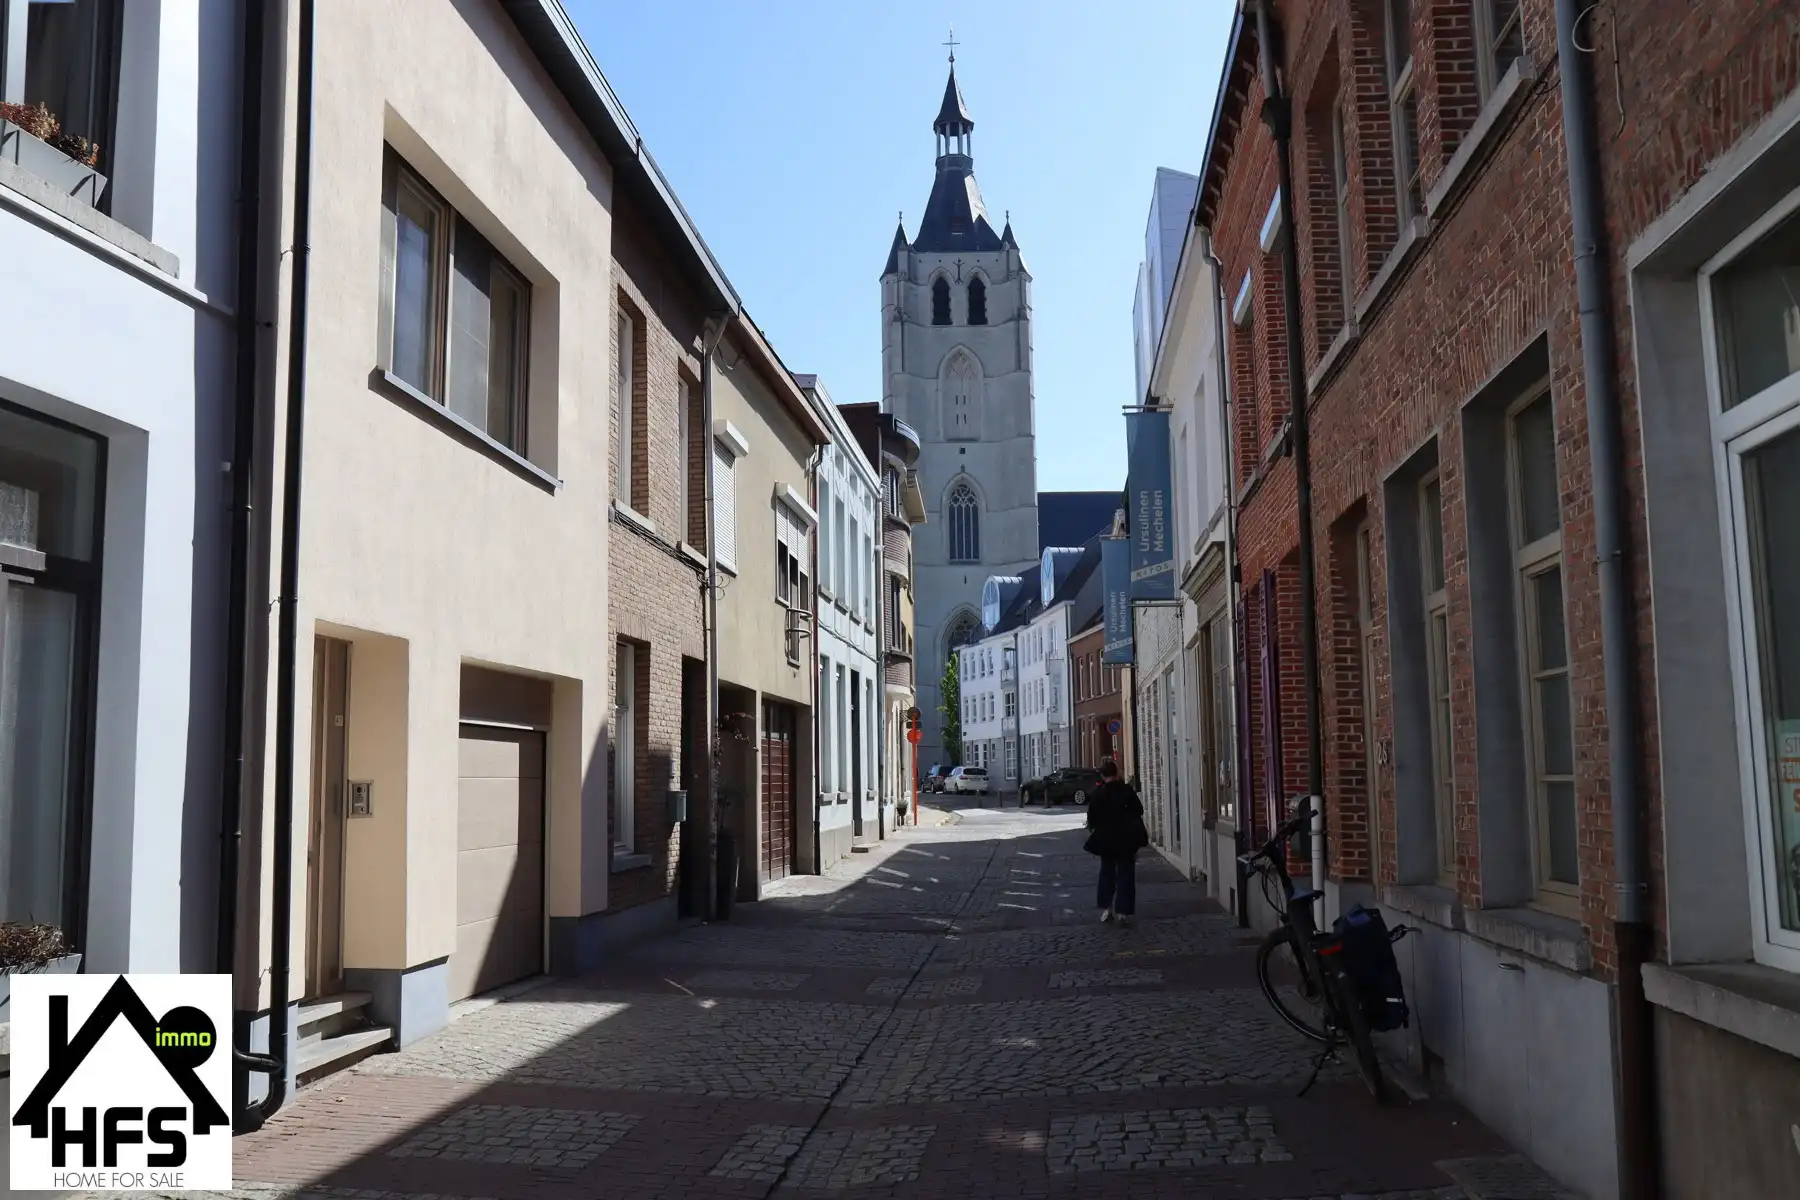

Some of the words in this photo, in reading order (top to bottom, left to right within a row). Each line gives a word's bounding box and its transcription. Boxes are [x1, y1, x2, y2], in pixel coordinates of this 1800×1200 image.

[1138, 490, 1150, 552] Ursulinen
[1153, 489, 1164, 552] Mechelen
[1136, 563, 1169, 579] KITOS
[1119, 591, 1127, 632] Mechelen
